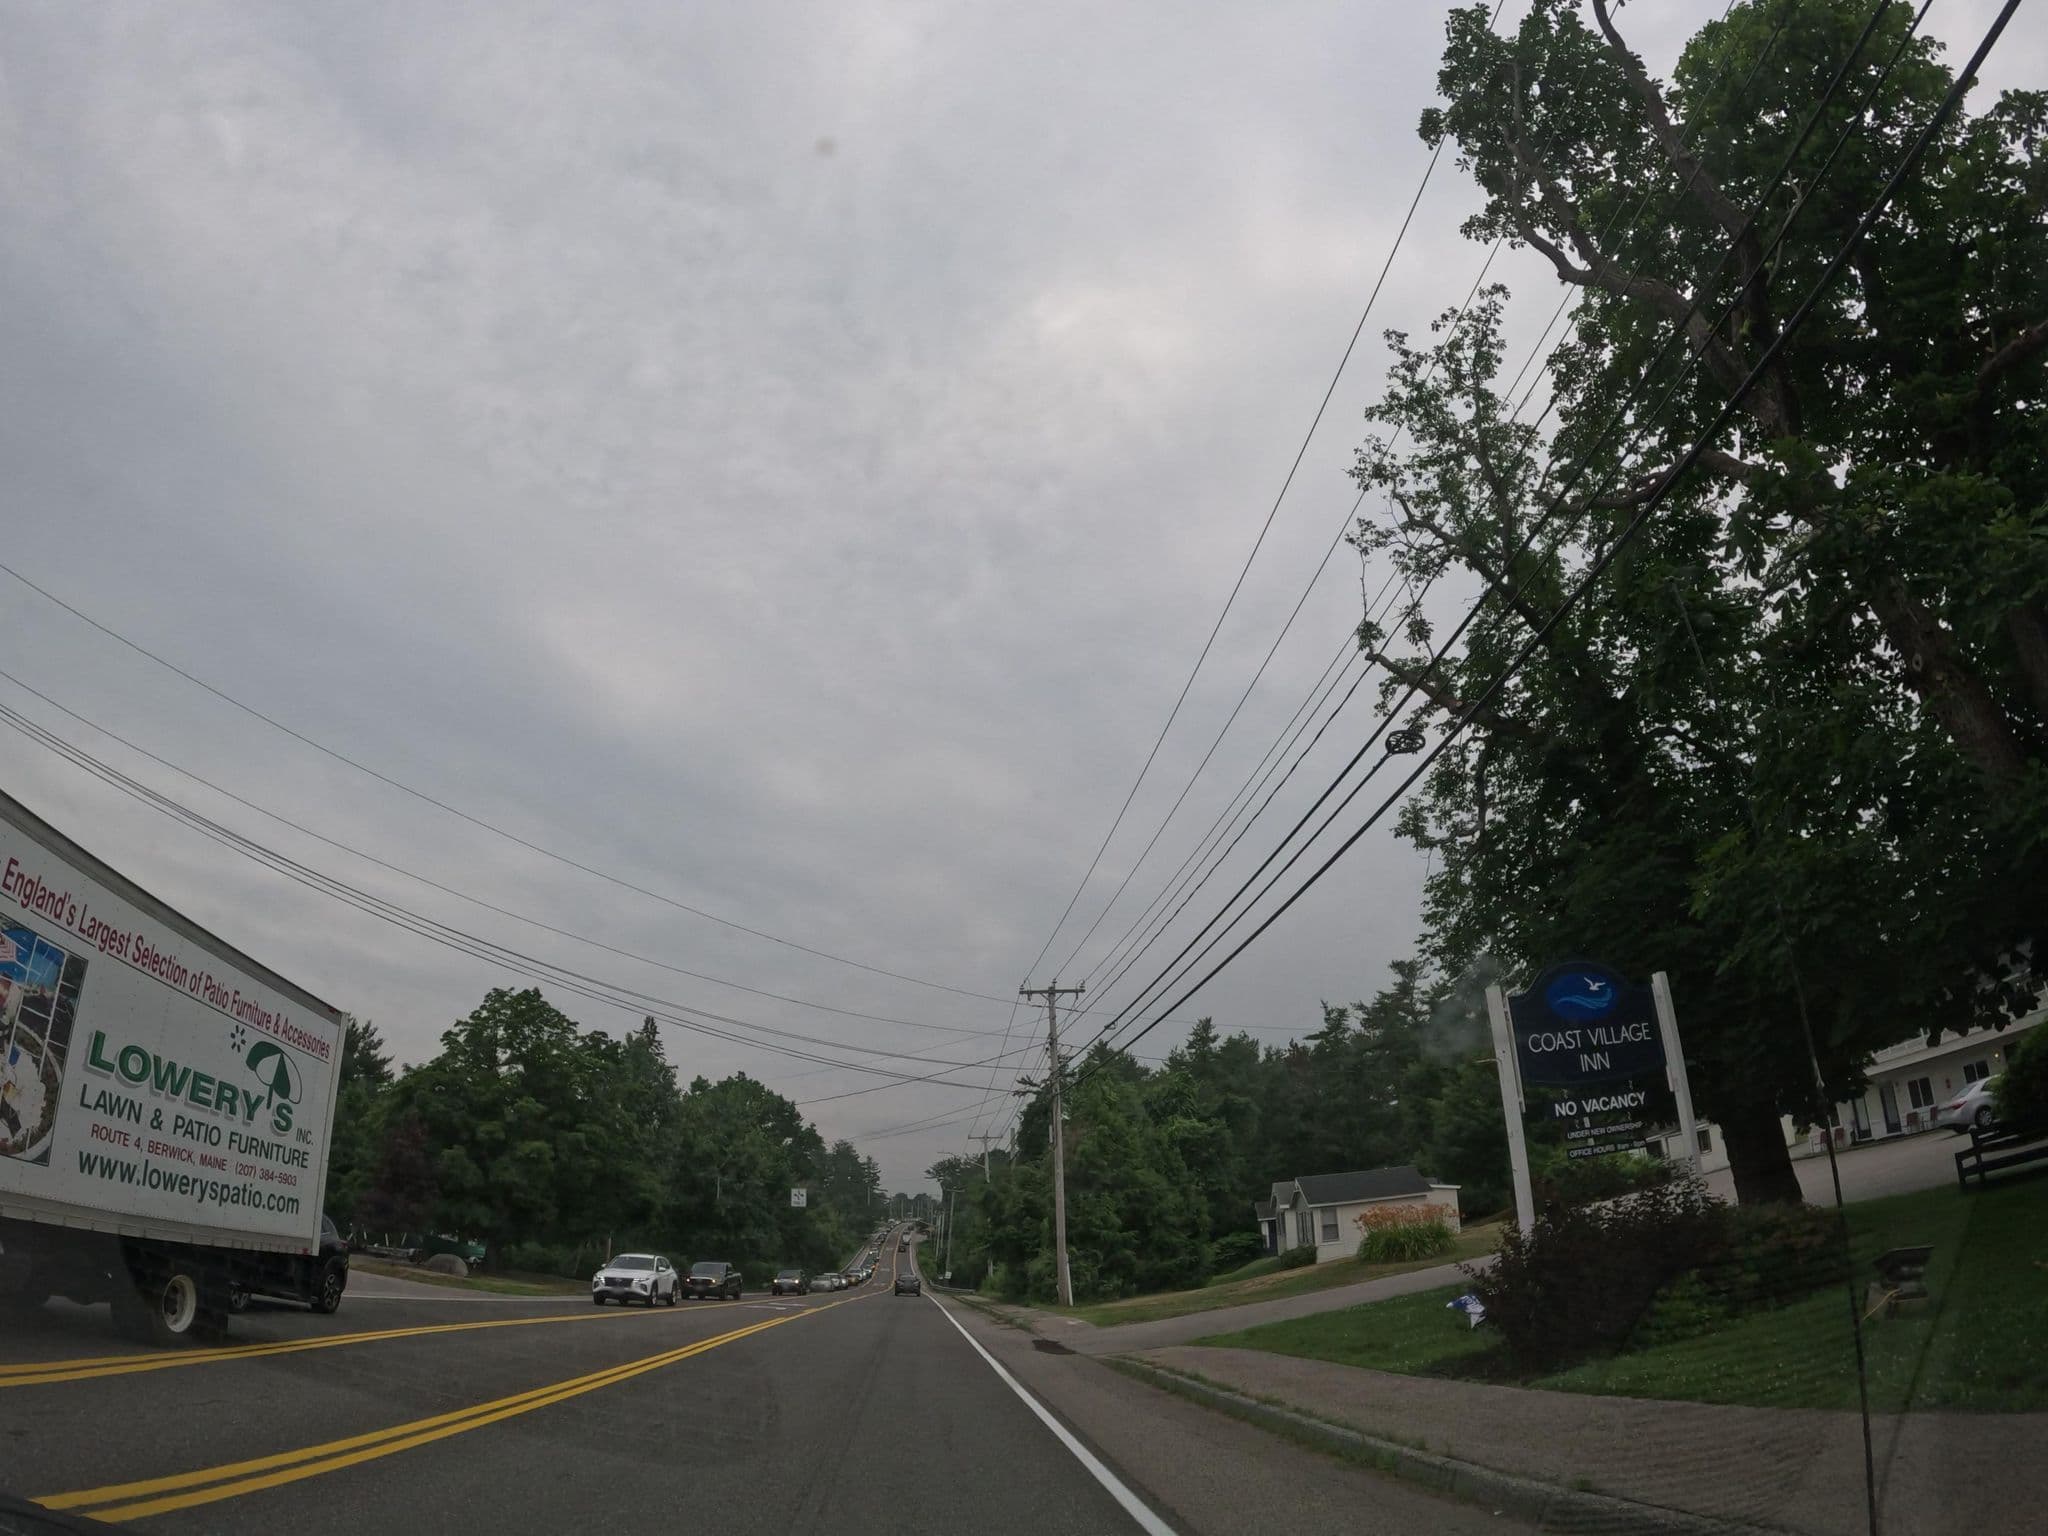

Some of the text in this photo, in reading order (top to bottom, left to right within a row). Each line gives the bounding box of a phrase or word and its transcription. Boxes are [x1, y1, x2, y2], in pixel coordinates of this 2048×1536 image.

[2, 857, 331, 1059] England's Largest Selection of Patio Furniture & Accessories
[1528, 1022, 1652, 1053] COAST VILLAGE
[1580, 1051, 1611, 1073] INN
[87, 1029, 314, 1146] LOWERY'S INC.
[1554, 1091, 1646, 1118] NO VACANCY
[79, 1083, 310, 1169] LAWN & PATIO FURNITURE
[1567, 1129, 1591, 1140] UNDER
[1590, 1126, 1606, 1137] NEW
[91, 1123, 131, 1148] ROUTE
[147, 1140, 196, 1166] BERWICK,
[199, 1153, 228, 1172] MAINE
[235, 1161, 257, 1180] (207)
[259, 1168, 297, 1187] 384-5903
[1569, 1147, 1593, 1158] OFFICE
[79, 1150, 301, 1216] www.loweryspatio.com
